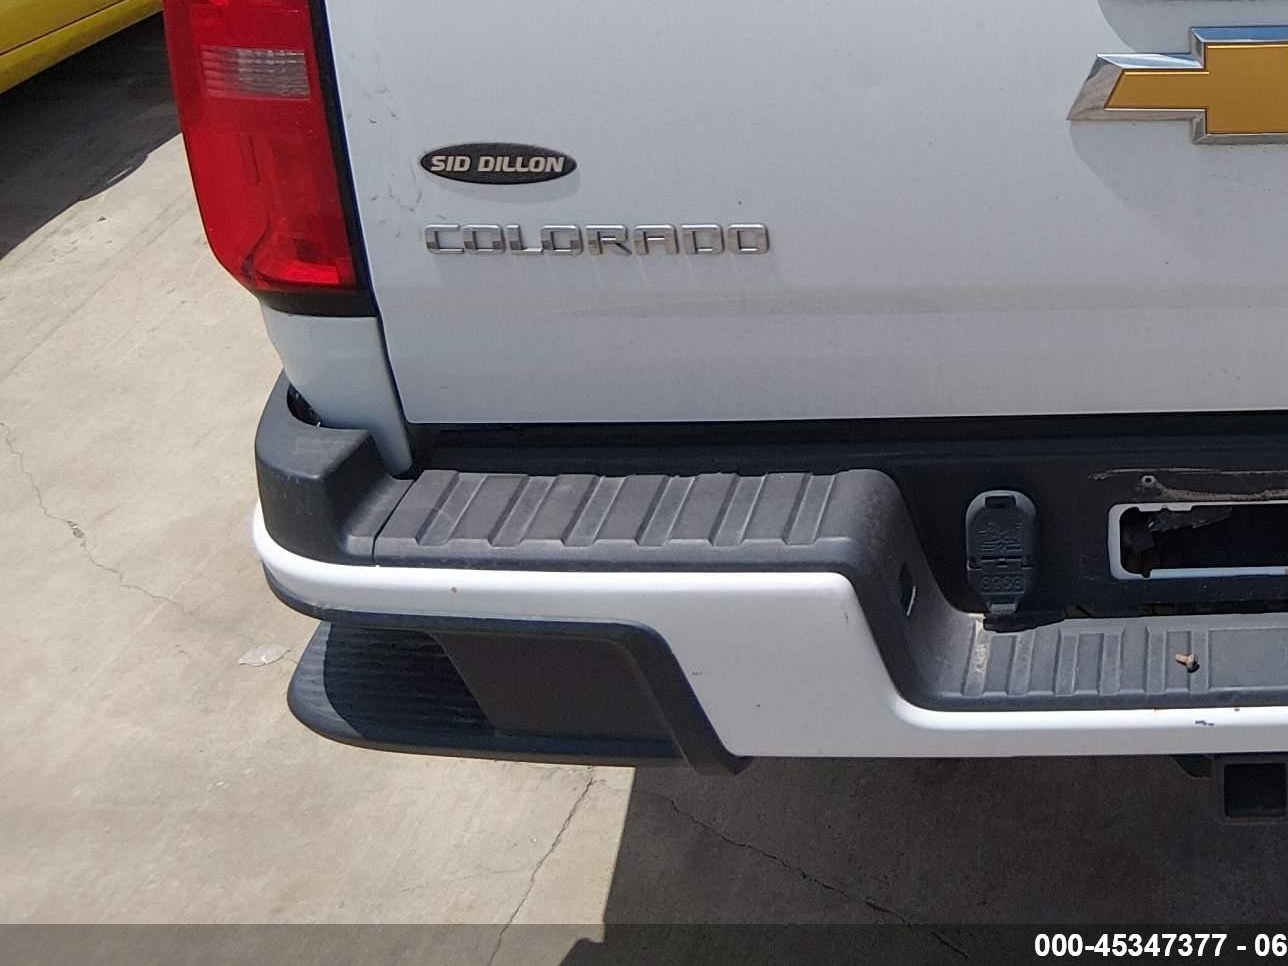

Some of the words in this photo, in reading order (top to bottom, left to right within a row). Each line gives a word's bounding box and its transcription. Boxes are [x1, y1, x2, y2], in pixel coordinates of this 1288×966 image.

[430, 155, 470, 172] SID
[478, 155, 565, 173] DILLON
[424, 223, 770, 256] COLORADO
